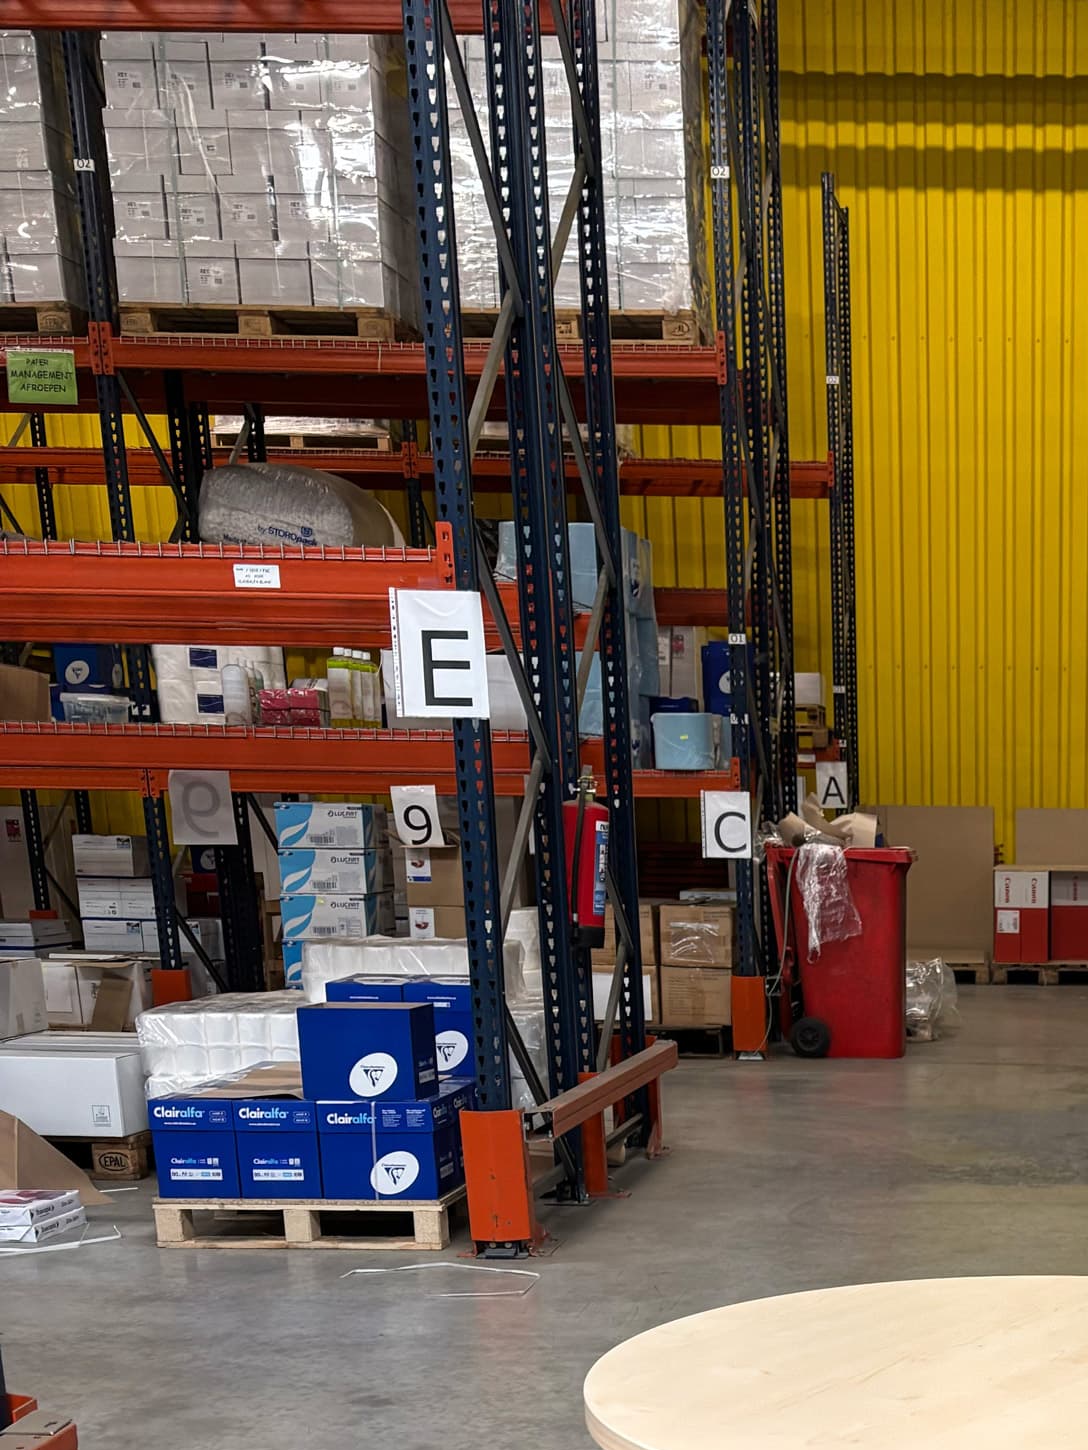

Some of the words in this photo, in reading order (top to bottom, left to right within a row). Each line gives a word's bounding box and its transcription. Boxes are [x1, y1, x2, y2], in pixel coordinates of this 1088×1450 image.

[77, 159, 91, 168] 02
[712, 167, 726, 176] 02
[11, 370, 73, 380] MANAGEMENT
[20, 384, 66, 392] AFROEPEN
[421, 630, 473, 707] E
[822, 776, 845, 805] A
[403, 805, 432, 845] 9
[714, 811, 747, 853] C
[154, 1106, 203, 1118] Clairalfa
[238, 1107, 287, 1119] Clairalfa
[103, 1156, 126, 1167] EPAL
